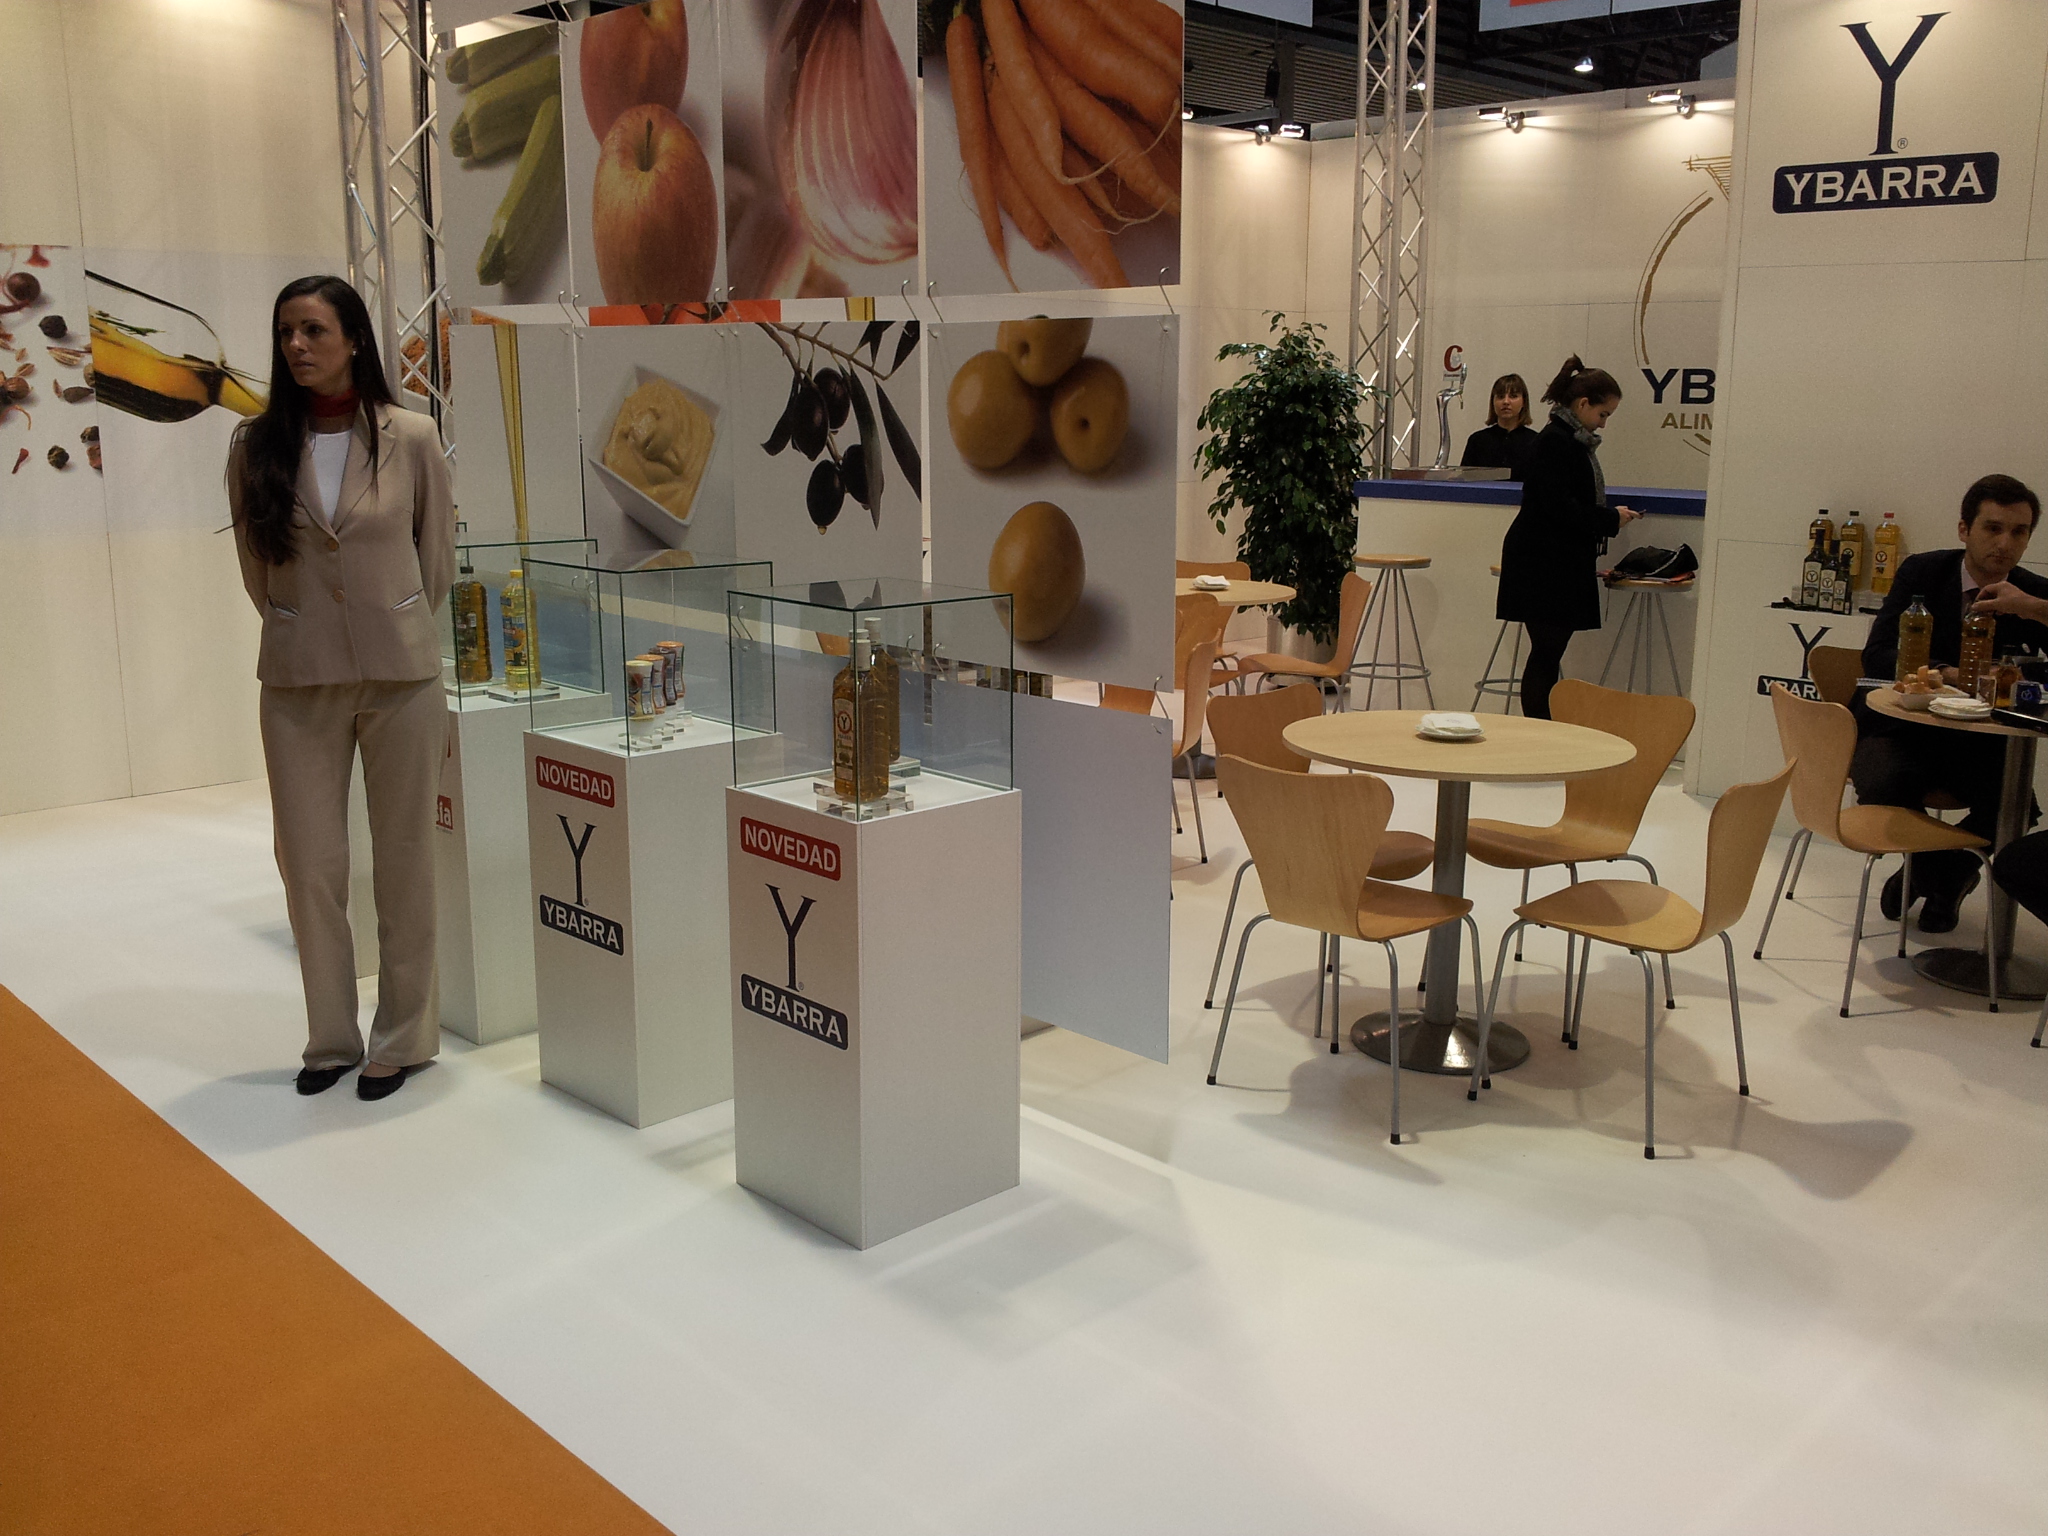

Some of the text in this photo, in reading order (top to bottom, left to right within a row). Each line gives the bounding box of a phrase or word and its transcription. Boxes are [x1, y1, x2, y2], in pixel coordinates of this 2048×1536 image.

[1839, 11, 1951, 156] Y
[1784, 161, 1985, 206] YBARRA
[1788, 622, 1833, 679] Y
[539, 761, 612, 801] NOVEDAD
[556, 813, 597, 908] Y
[745, 823, 837, 873] NOVEDAD
[543, 900, 620, 950] YBARRA
[765, 883, 817, 992] Y
[746, 980, 843, 1044] YBARRA
